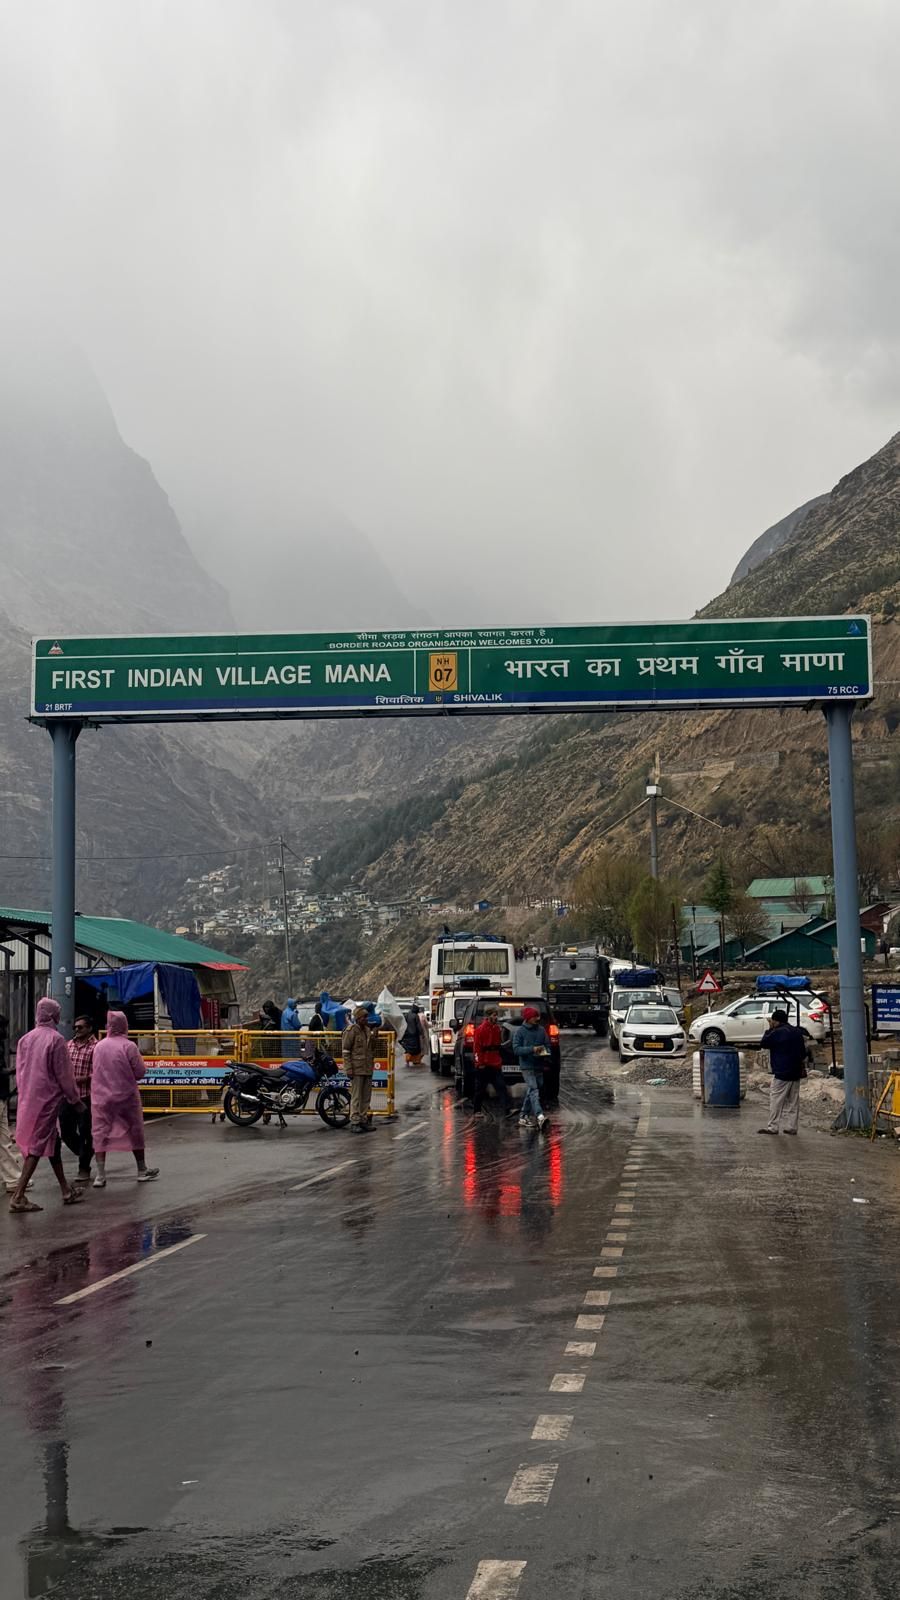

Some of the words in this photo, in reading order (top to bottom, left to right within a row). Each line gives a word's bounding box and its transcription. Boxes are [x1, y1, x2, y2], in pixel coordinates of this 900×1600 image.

[356, 632, 377, 641] सीमा
[382, 632, 406, 641] सड़क
[411, 631, 439, 639] संगठन
[477, 630, 505, 638] स्वागत
[510, 629, 534, 637] करता
[538, 628, 546, 637] है
[407, 640, 477, 648] ORGANISATION
[479, 638, 532, 646] WELCOMES
[436, 657, 450, 665] NH
[504, 659, 570, 679] भारत
[585, 658, 622, 677] का
[636, 656, 698, 676] प्रथम
[715, 648, 765, 674] गाँव
[780, 652, 845, 672] माणा
[52, 669, 114, 690] FIRST
[128, 667, 203, 688] INDIAN
[216, 665, 311, 686] VILLAGE
[325, 663, 391, 684] MANA
[434, 668, 453, 682] 07
[827, 686, 838, 694] 75
[839, 685, 859, 694] RCC
[375, 694, 424, 704] शिवालिक
[453, 693, 503, 702] SHIVALIK
[45, 703, 53, 711] 21
[54, 703, 73, 711] BRTF
